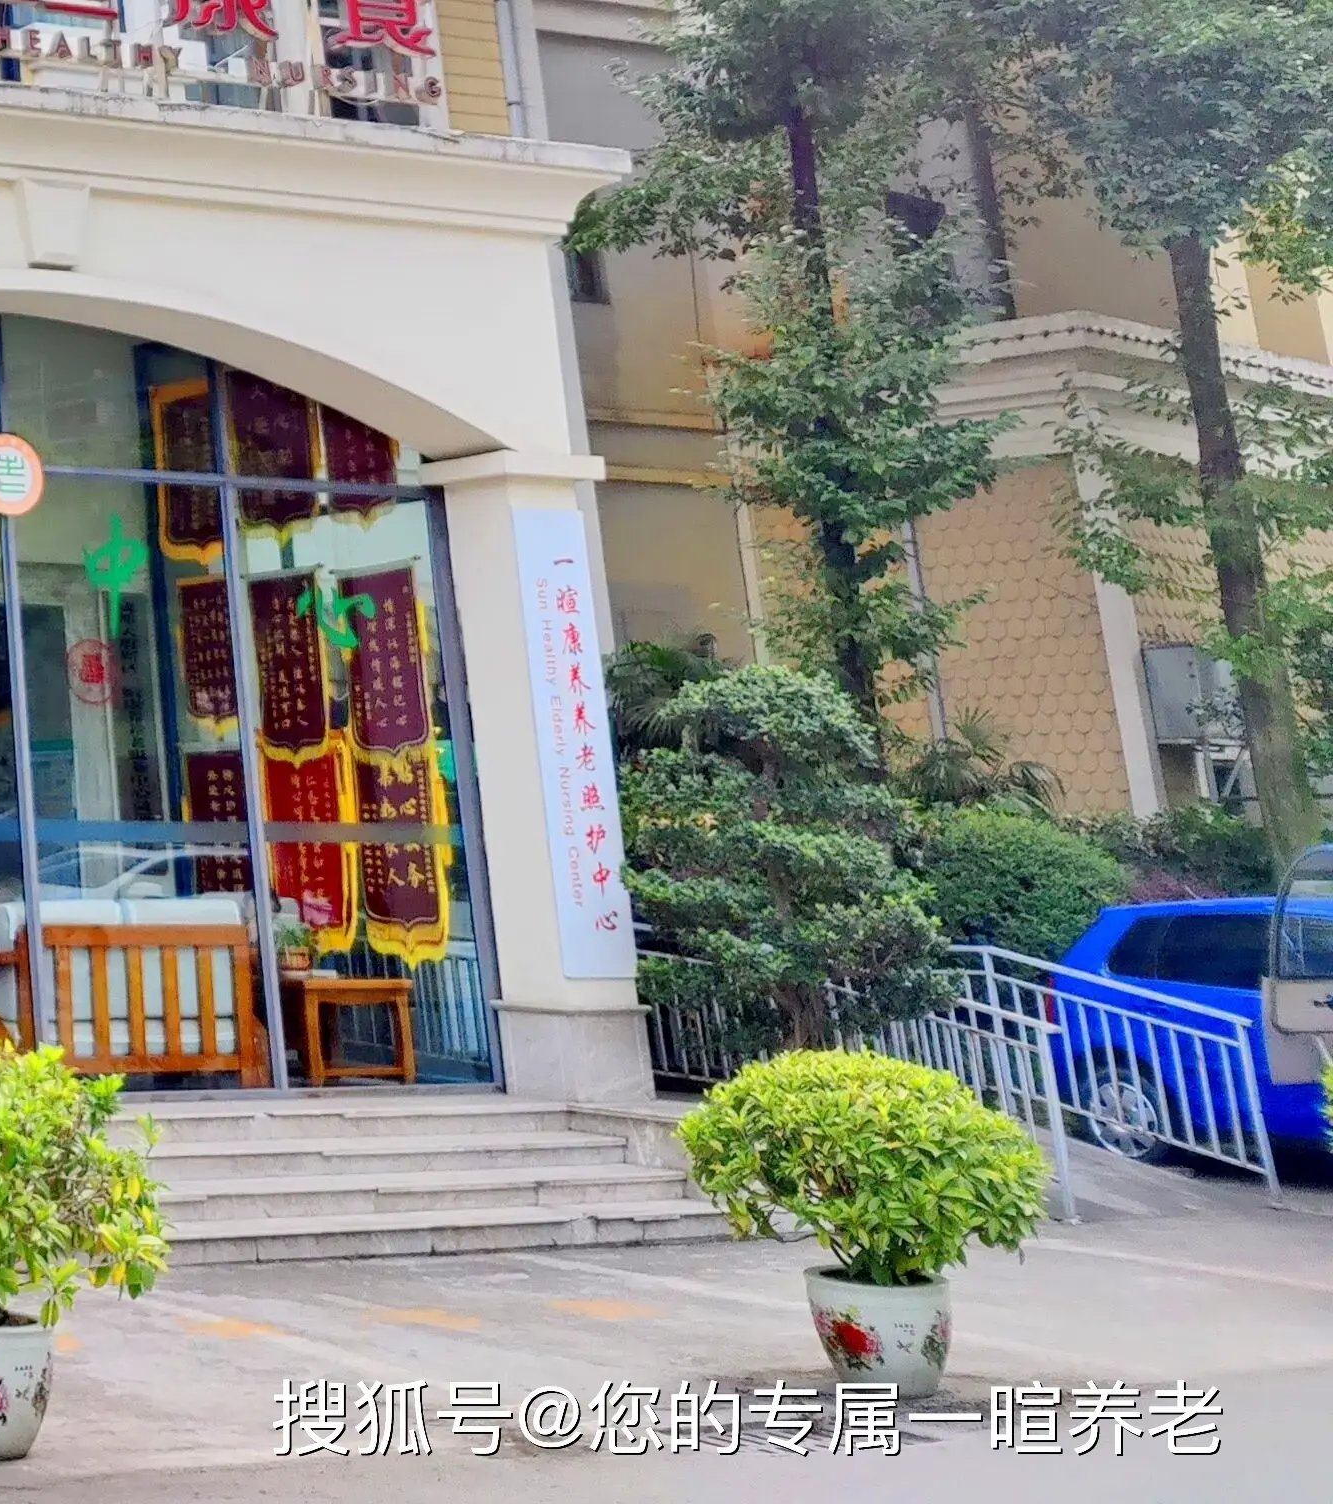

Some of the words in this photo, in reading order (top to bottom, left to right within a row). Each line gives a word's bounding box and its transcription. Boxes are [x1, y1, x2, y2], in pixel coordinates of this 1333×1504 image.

[249, 56, 443, 99] NURSING
[536, 577, 549, 610] Sun
[541, 619, 557, 686] Healthy
[550, 695, 566, 757] Elderly
[559, 766, 576, 837] Nursing
[568, 846, 584, 908] Center
